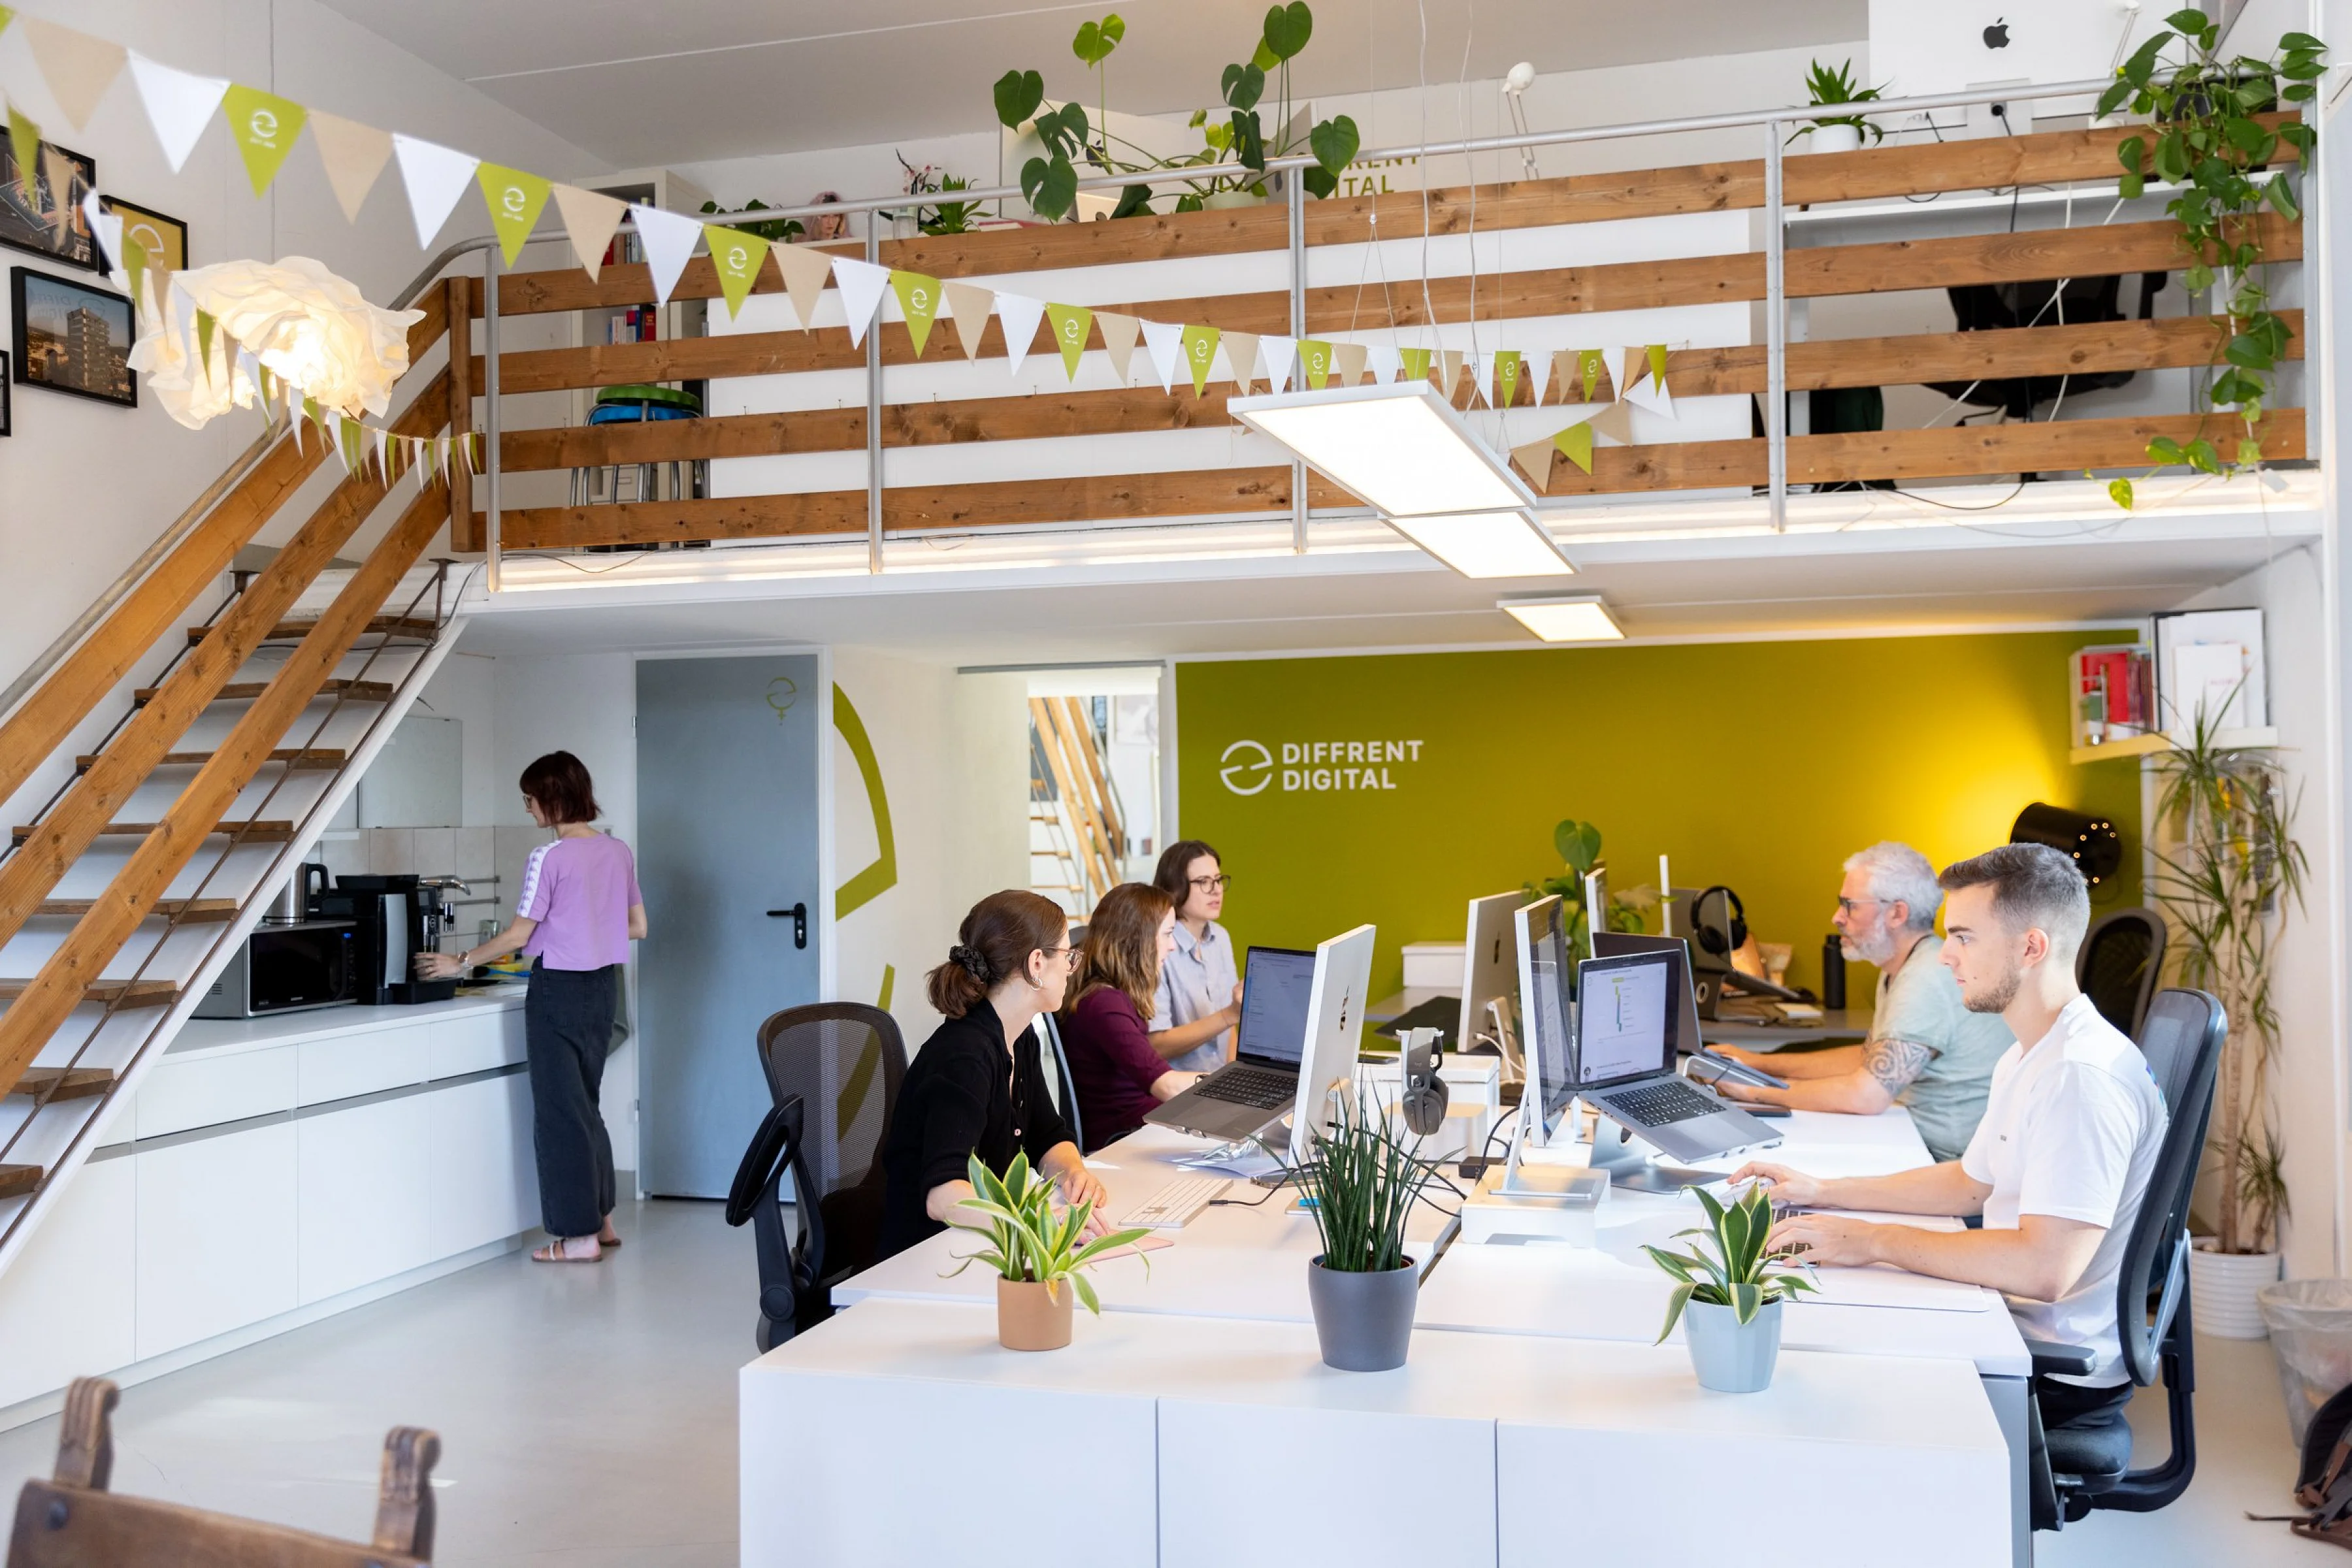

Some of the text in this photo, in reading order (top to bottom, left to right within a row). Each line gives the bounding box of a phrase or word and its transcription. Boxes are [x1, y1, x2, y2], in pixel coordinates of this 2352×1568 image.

[1334, 174, 1394, 197] ITAL
[1282, 740, 1424, 764] DIFFRENT
[1282, 768, 1396, 791] DIGITAL
